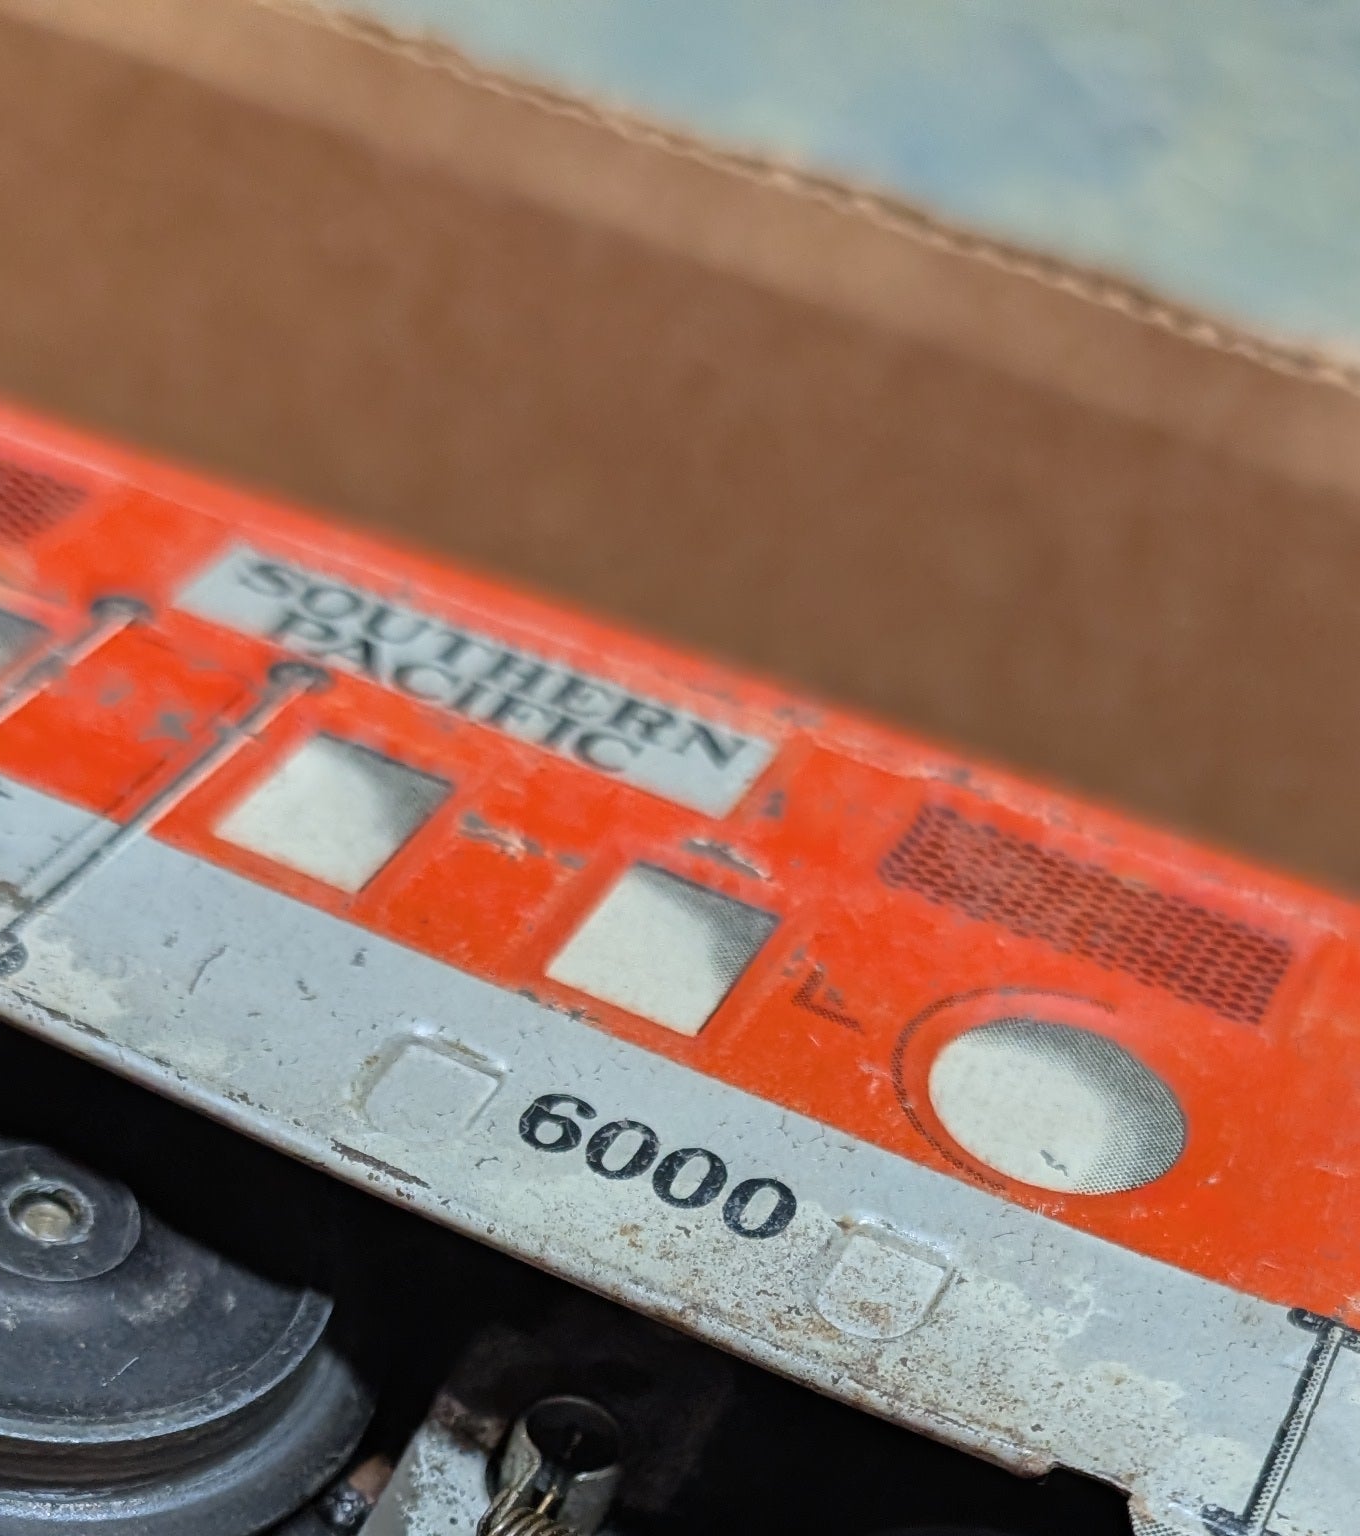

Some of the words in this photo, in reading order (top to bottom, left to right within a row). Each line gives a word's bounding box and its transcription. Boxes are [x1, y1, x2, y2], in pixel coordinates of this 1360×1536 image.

[236, 556, 746, 771] SOUTHERN
[267, 610, 640, 772] PACIFIC
[518, 1093, 796, 1239] 6000
